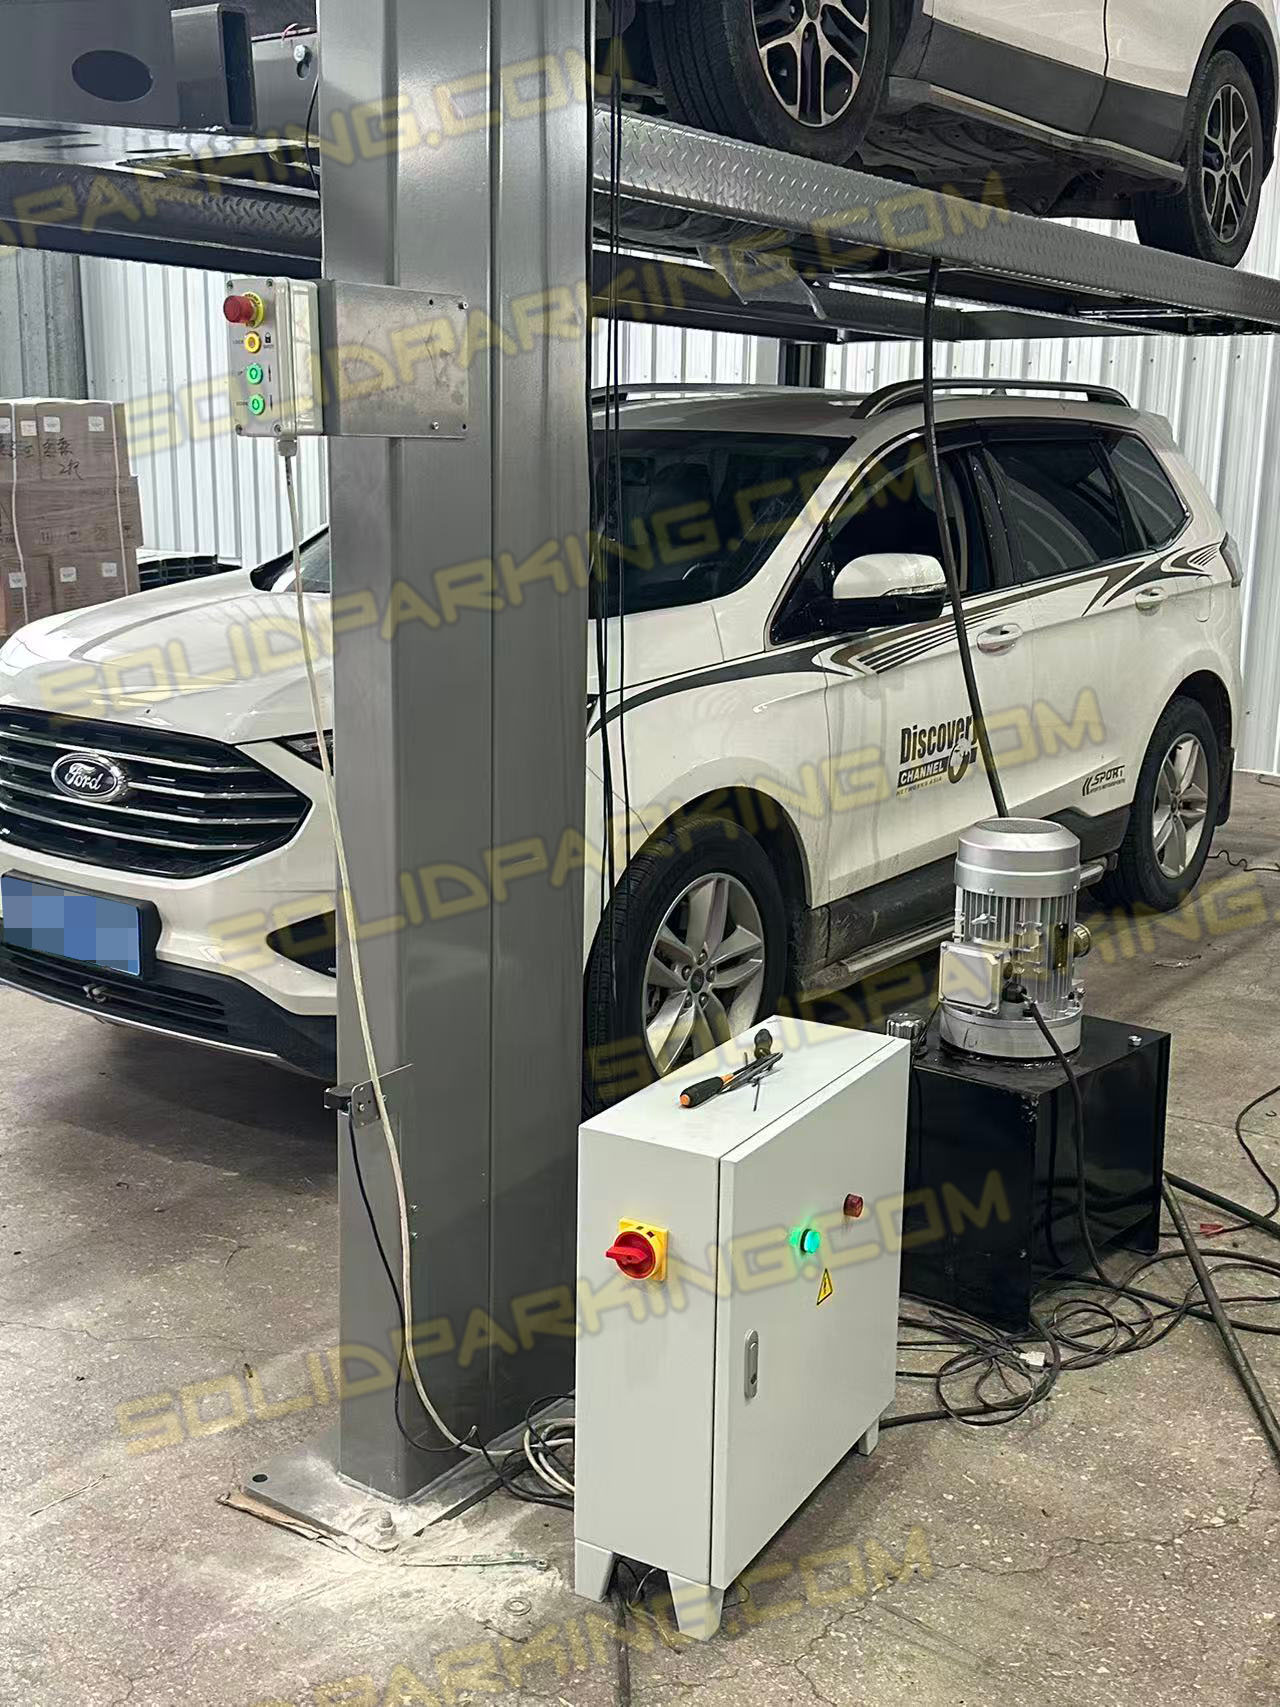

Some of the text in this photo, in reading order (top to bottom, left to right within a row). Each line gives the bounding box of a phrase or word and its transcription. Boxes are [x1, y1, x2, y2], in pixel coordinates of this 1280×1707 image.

[64, 762, 104, 791] Ford
[900, 760, 946, 785] CHANNEL
[1091, 765, 1125, 787] SPORT
